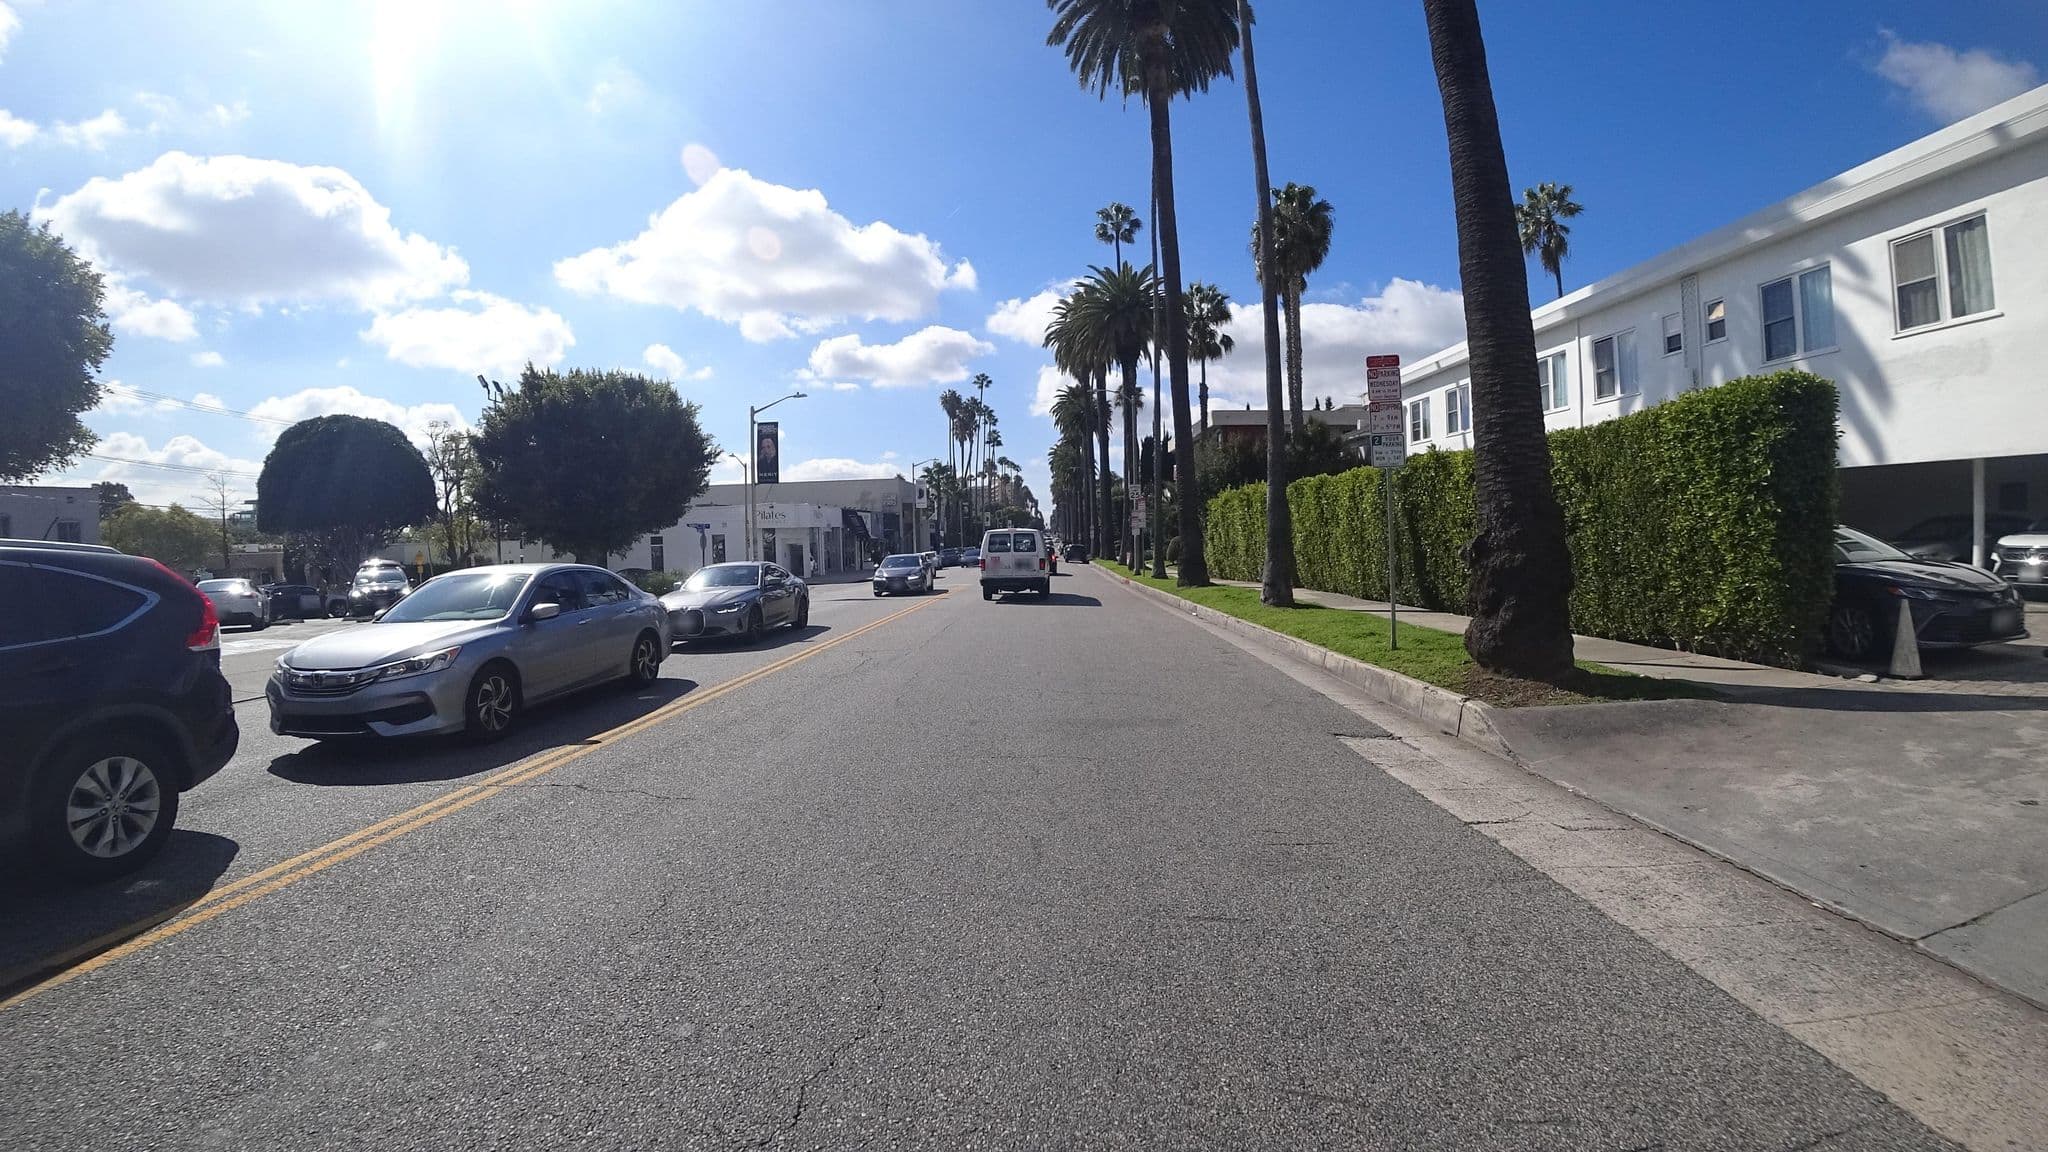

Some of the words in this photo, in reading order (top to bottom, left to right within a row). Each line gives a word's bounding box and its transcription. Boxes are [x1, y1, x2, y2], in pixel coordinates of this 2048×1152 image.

[1369, 370, 1378, 378] NO
[1378, 369, 1399, 377] PARKING
[1370, 380, 1398, 388] WEDNESDAY
[1370, 403, 1379, 412] NO
[1374, 437, 1380, 445] 2
